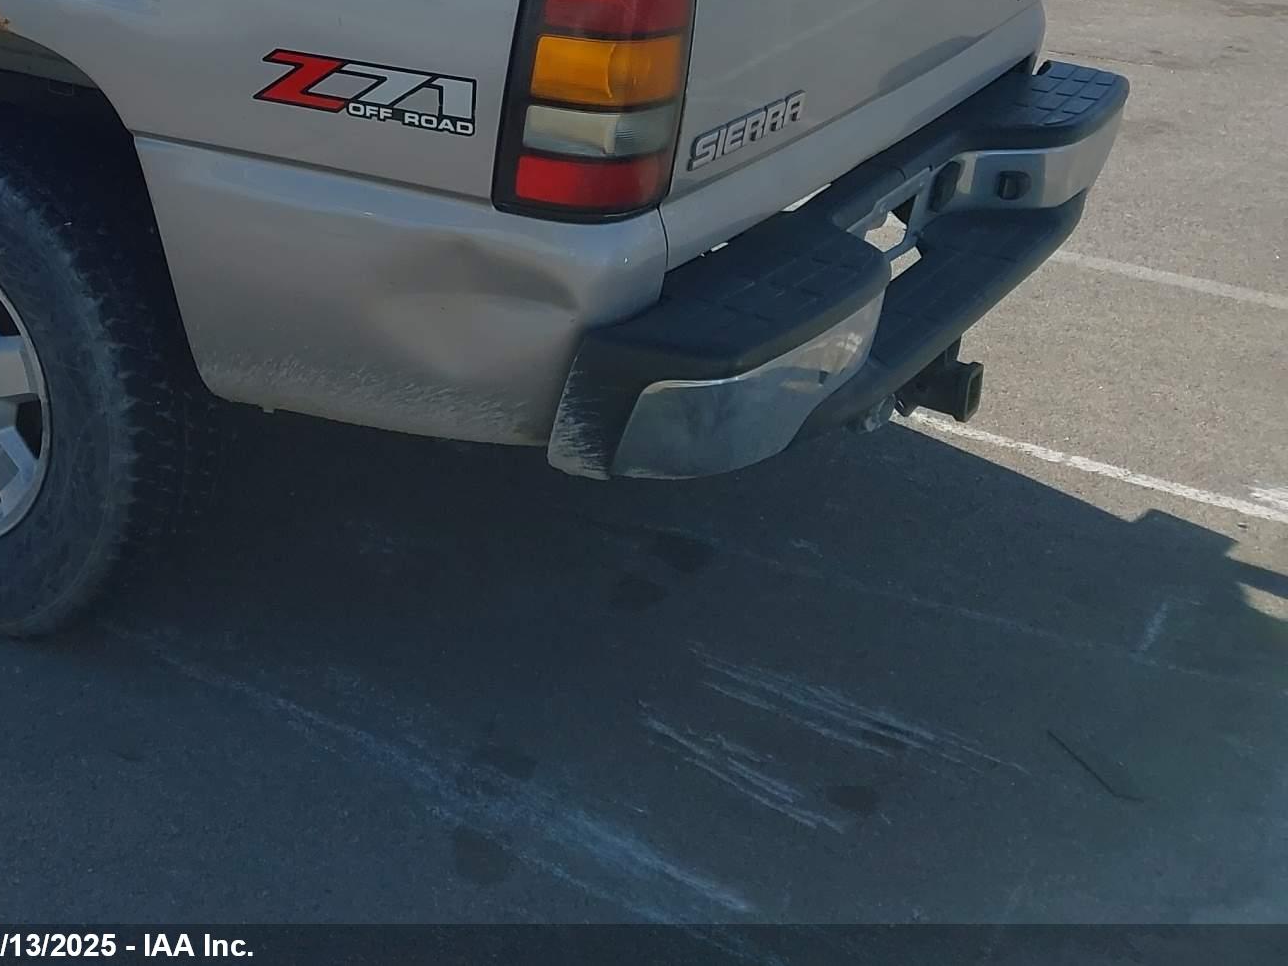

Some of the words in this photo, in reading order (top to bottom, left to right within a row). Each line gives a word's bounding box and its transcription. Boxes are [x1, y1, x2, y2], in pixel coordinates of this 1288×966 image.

[253, 48, 477, 122] Z71
[347, 101, 394, 121] OFF
[402, 111, 475, 136] ROAD
[687, 90, 805, 171] SIERRA
